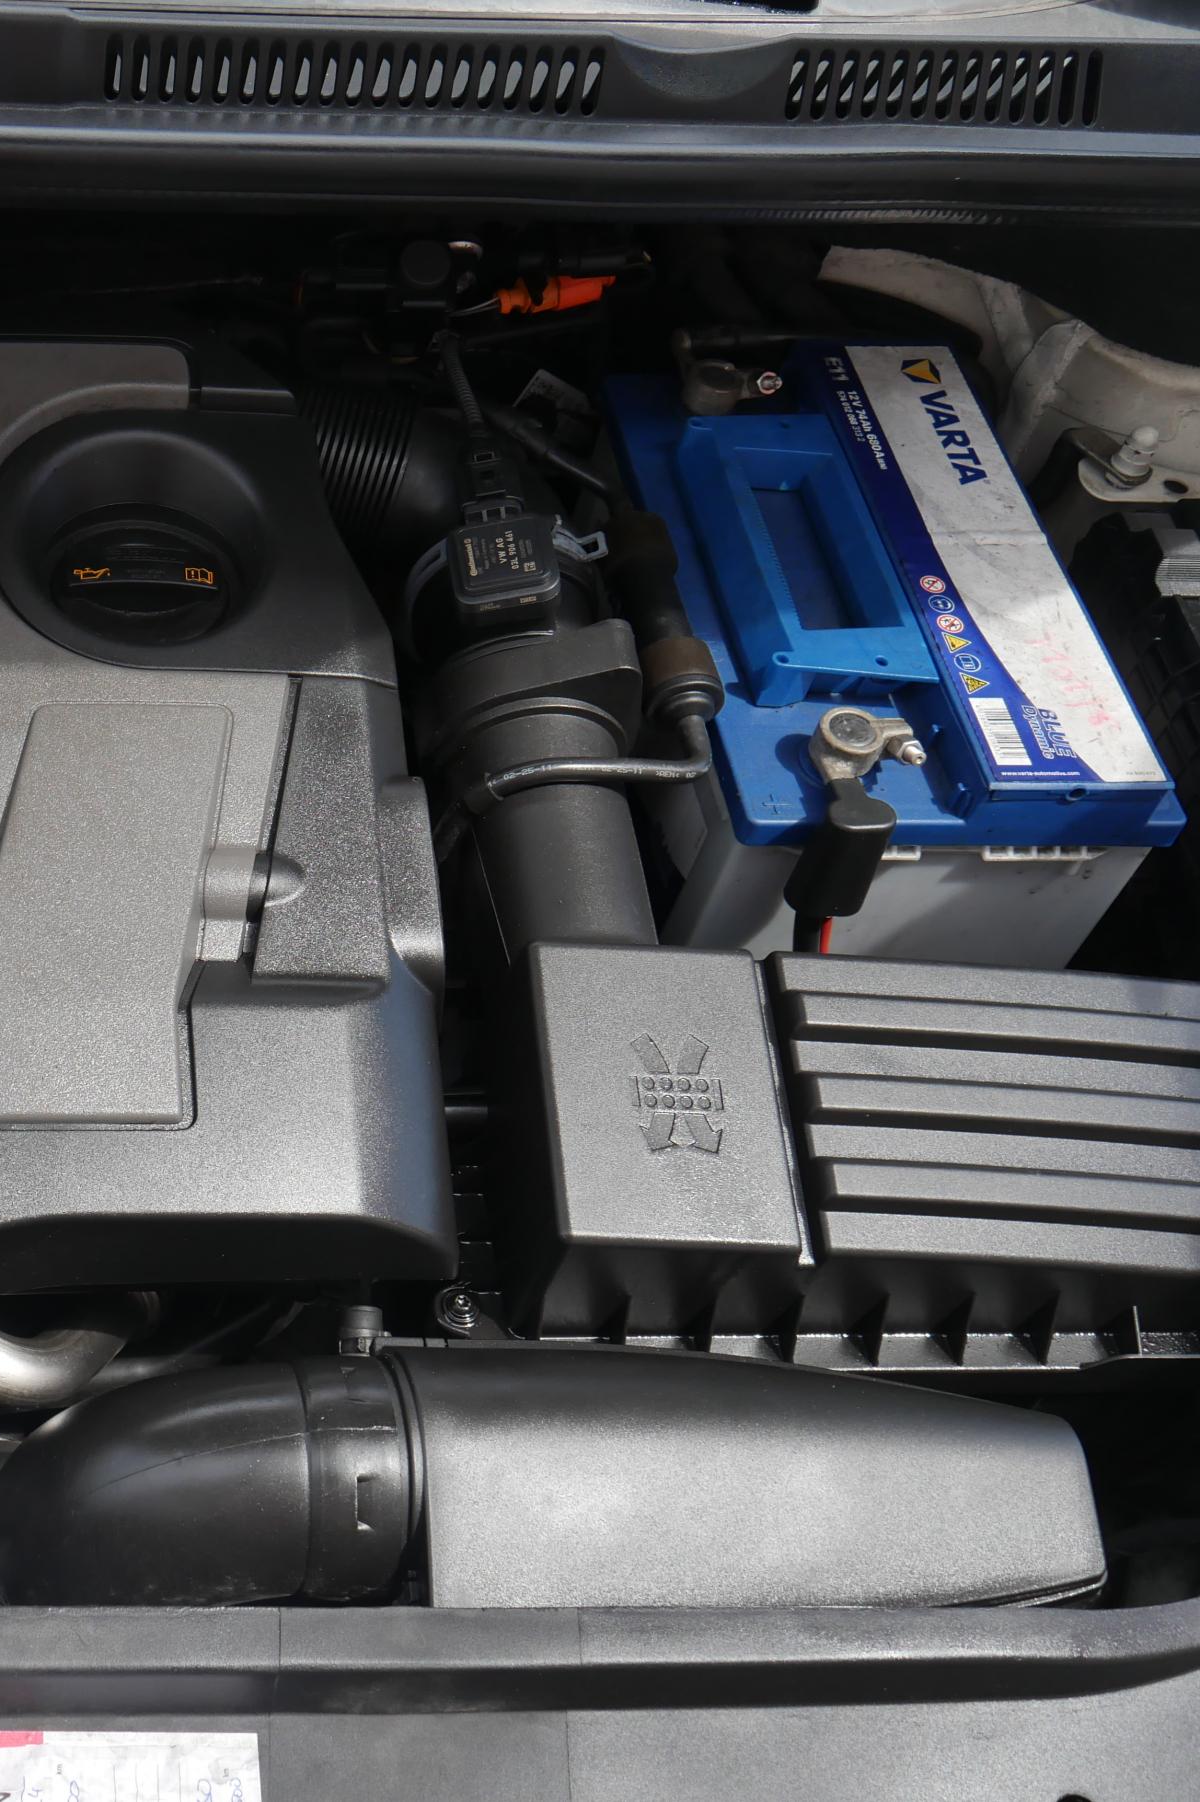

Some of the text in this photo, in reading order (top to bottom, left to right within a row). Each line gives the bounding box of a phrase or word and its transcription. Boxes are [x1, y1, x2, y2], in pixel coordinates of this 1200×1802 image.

[920, 390, 987, 485] VARTA
[1022, 705, 1054, 760] Dynamic
[1038, 708, 1077, 759] BLUE
